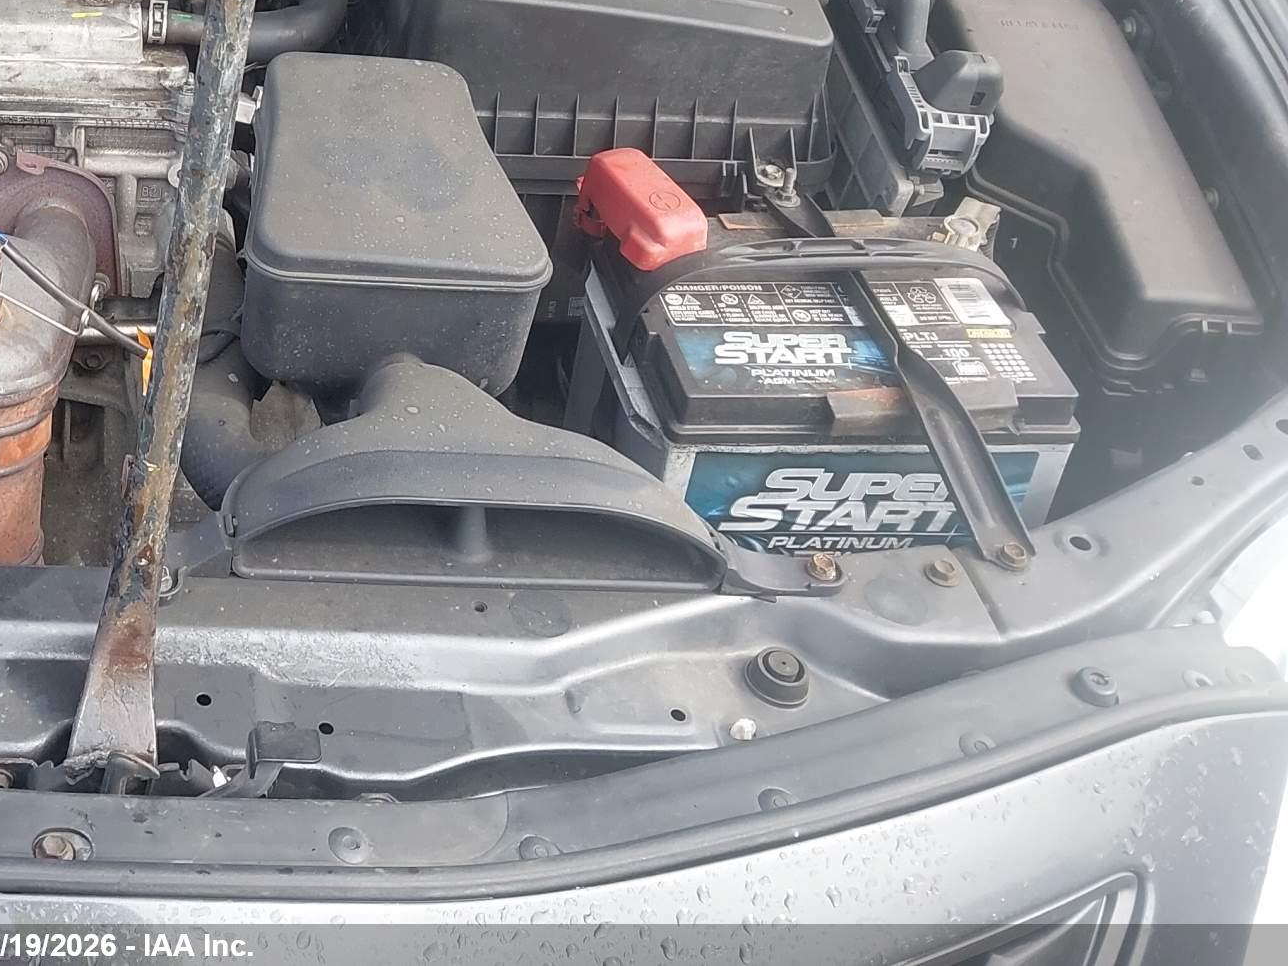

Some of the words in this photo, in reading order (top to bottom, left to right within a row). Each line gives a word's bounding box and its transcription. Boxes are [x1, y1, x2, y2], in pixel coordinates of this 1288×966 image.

[675, 284, 763, 292] DANGER/POISON
[723, 331, 848, 348] SUPER
[714, 343, 855, 365] START
[750, 368, 836, 377] PLATINUM
[717, 494, 957, 532] START
[767, 536, 914, 550] PLATINUM
